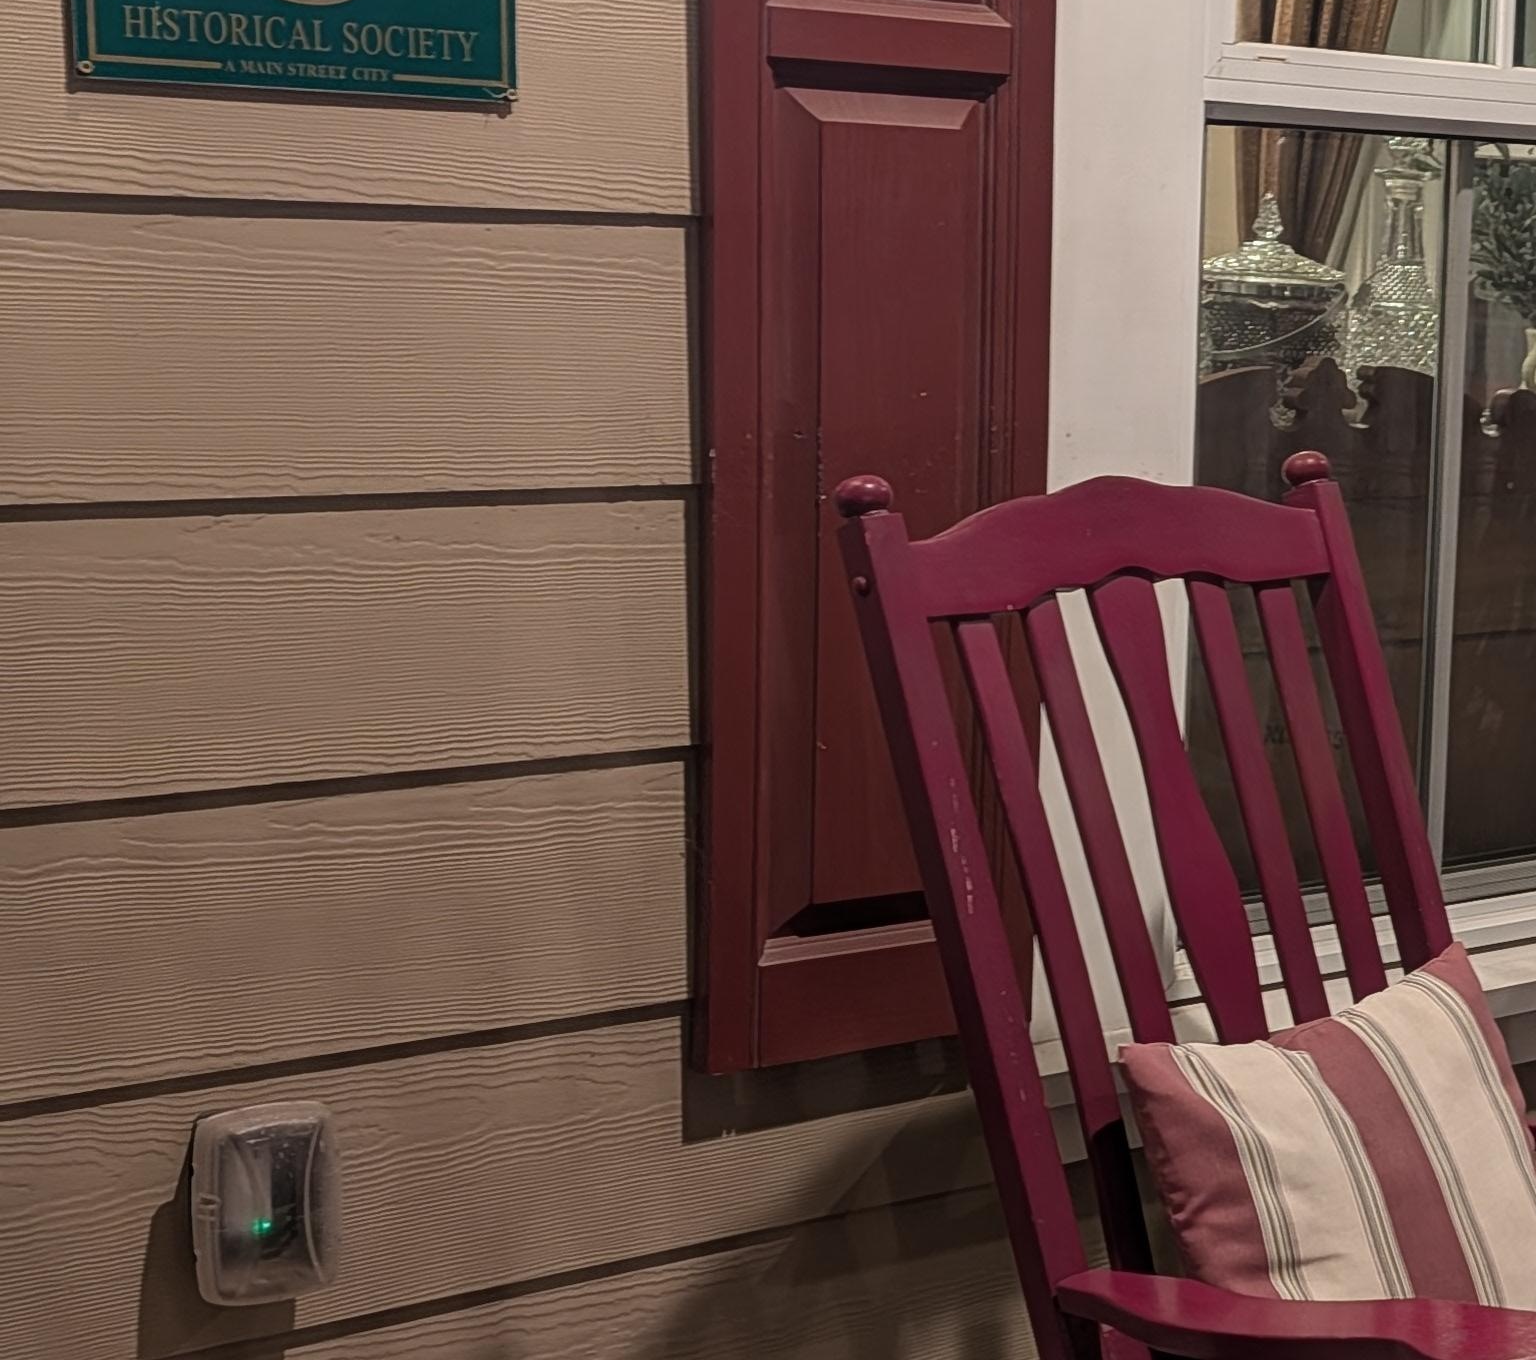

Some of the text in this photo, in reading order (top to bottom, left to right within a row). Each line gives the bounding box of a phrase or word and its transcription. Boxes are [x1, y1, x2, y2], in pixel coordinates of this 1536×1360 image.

[123, 3, 479, 62] HISTORICAL SOCIETY
[224, 59, 392, 81] A MAIN STREET CITY
